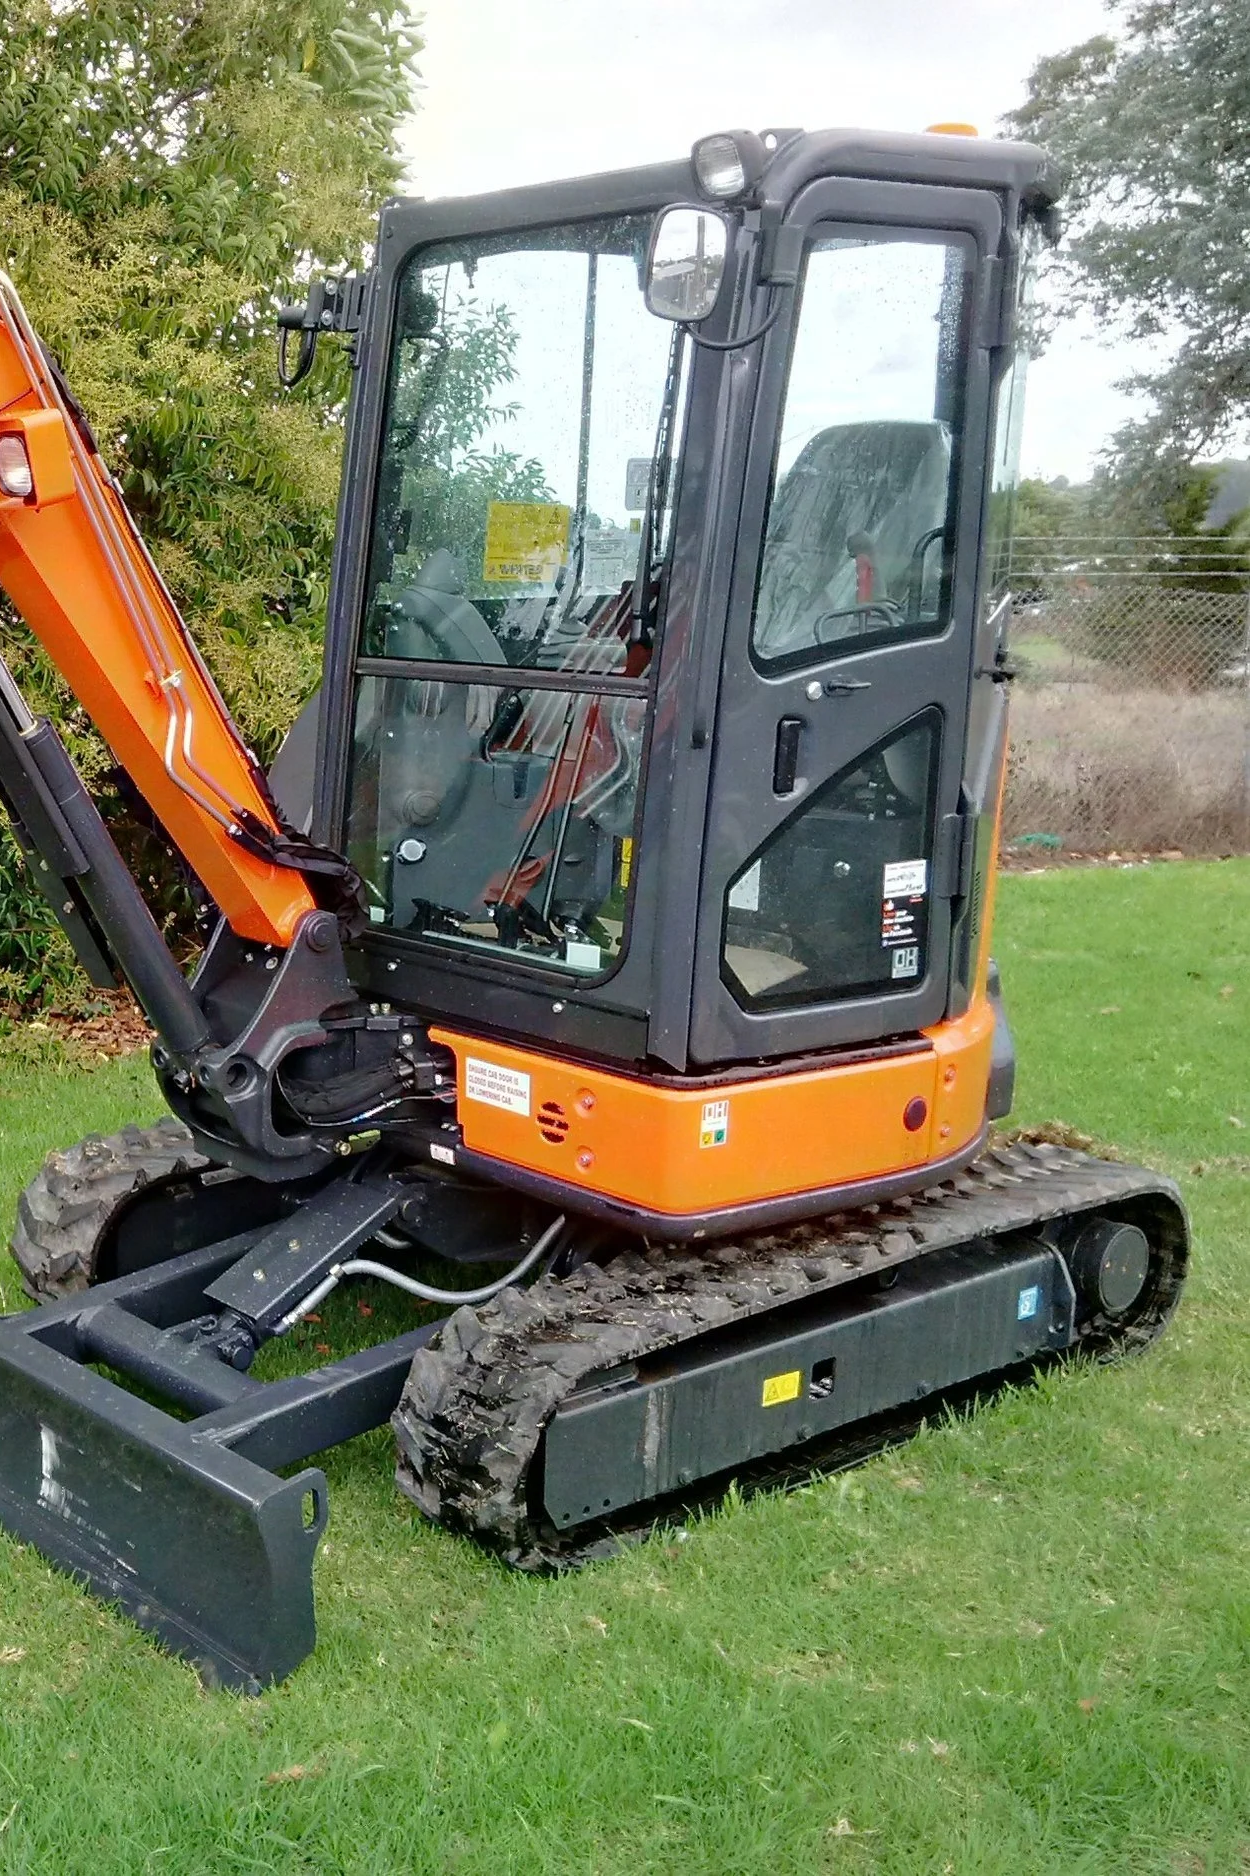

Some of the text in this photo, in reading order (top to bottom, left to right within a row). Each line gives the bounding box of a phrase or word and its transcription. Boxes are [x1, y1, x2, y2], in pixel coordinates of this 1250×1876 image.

[488, 1070, 498, 1080] CAB
[498, 1073, 513, 1084] DOOR
[468, 1074, 527, 1100] CLOSED BEFORE RAISING
[476, 1088, 501, 1102] LOWERING
